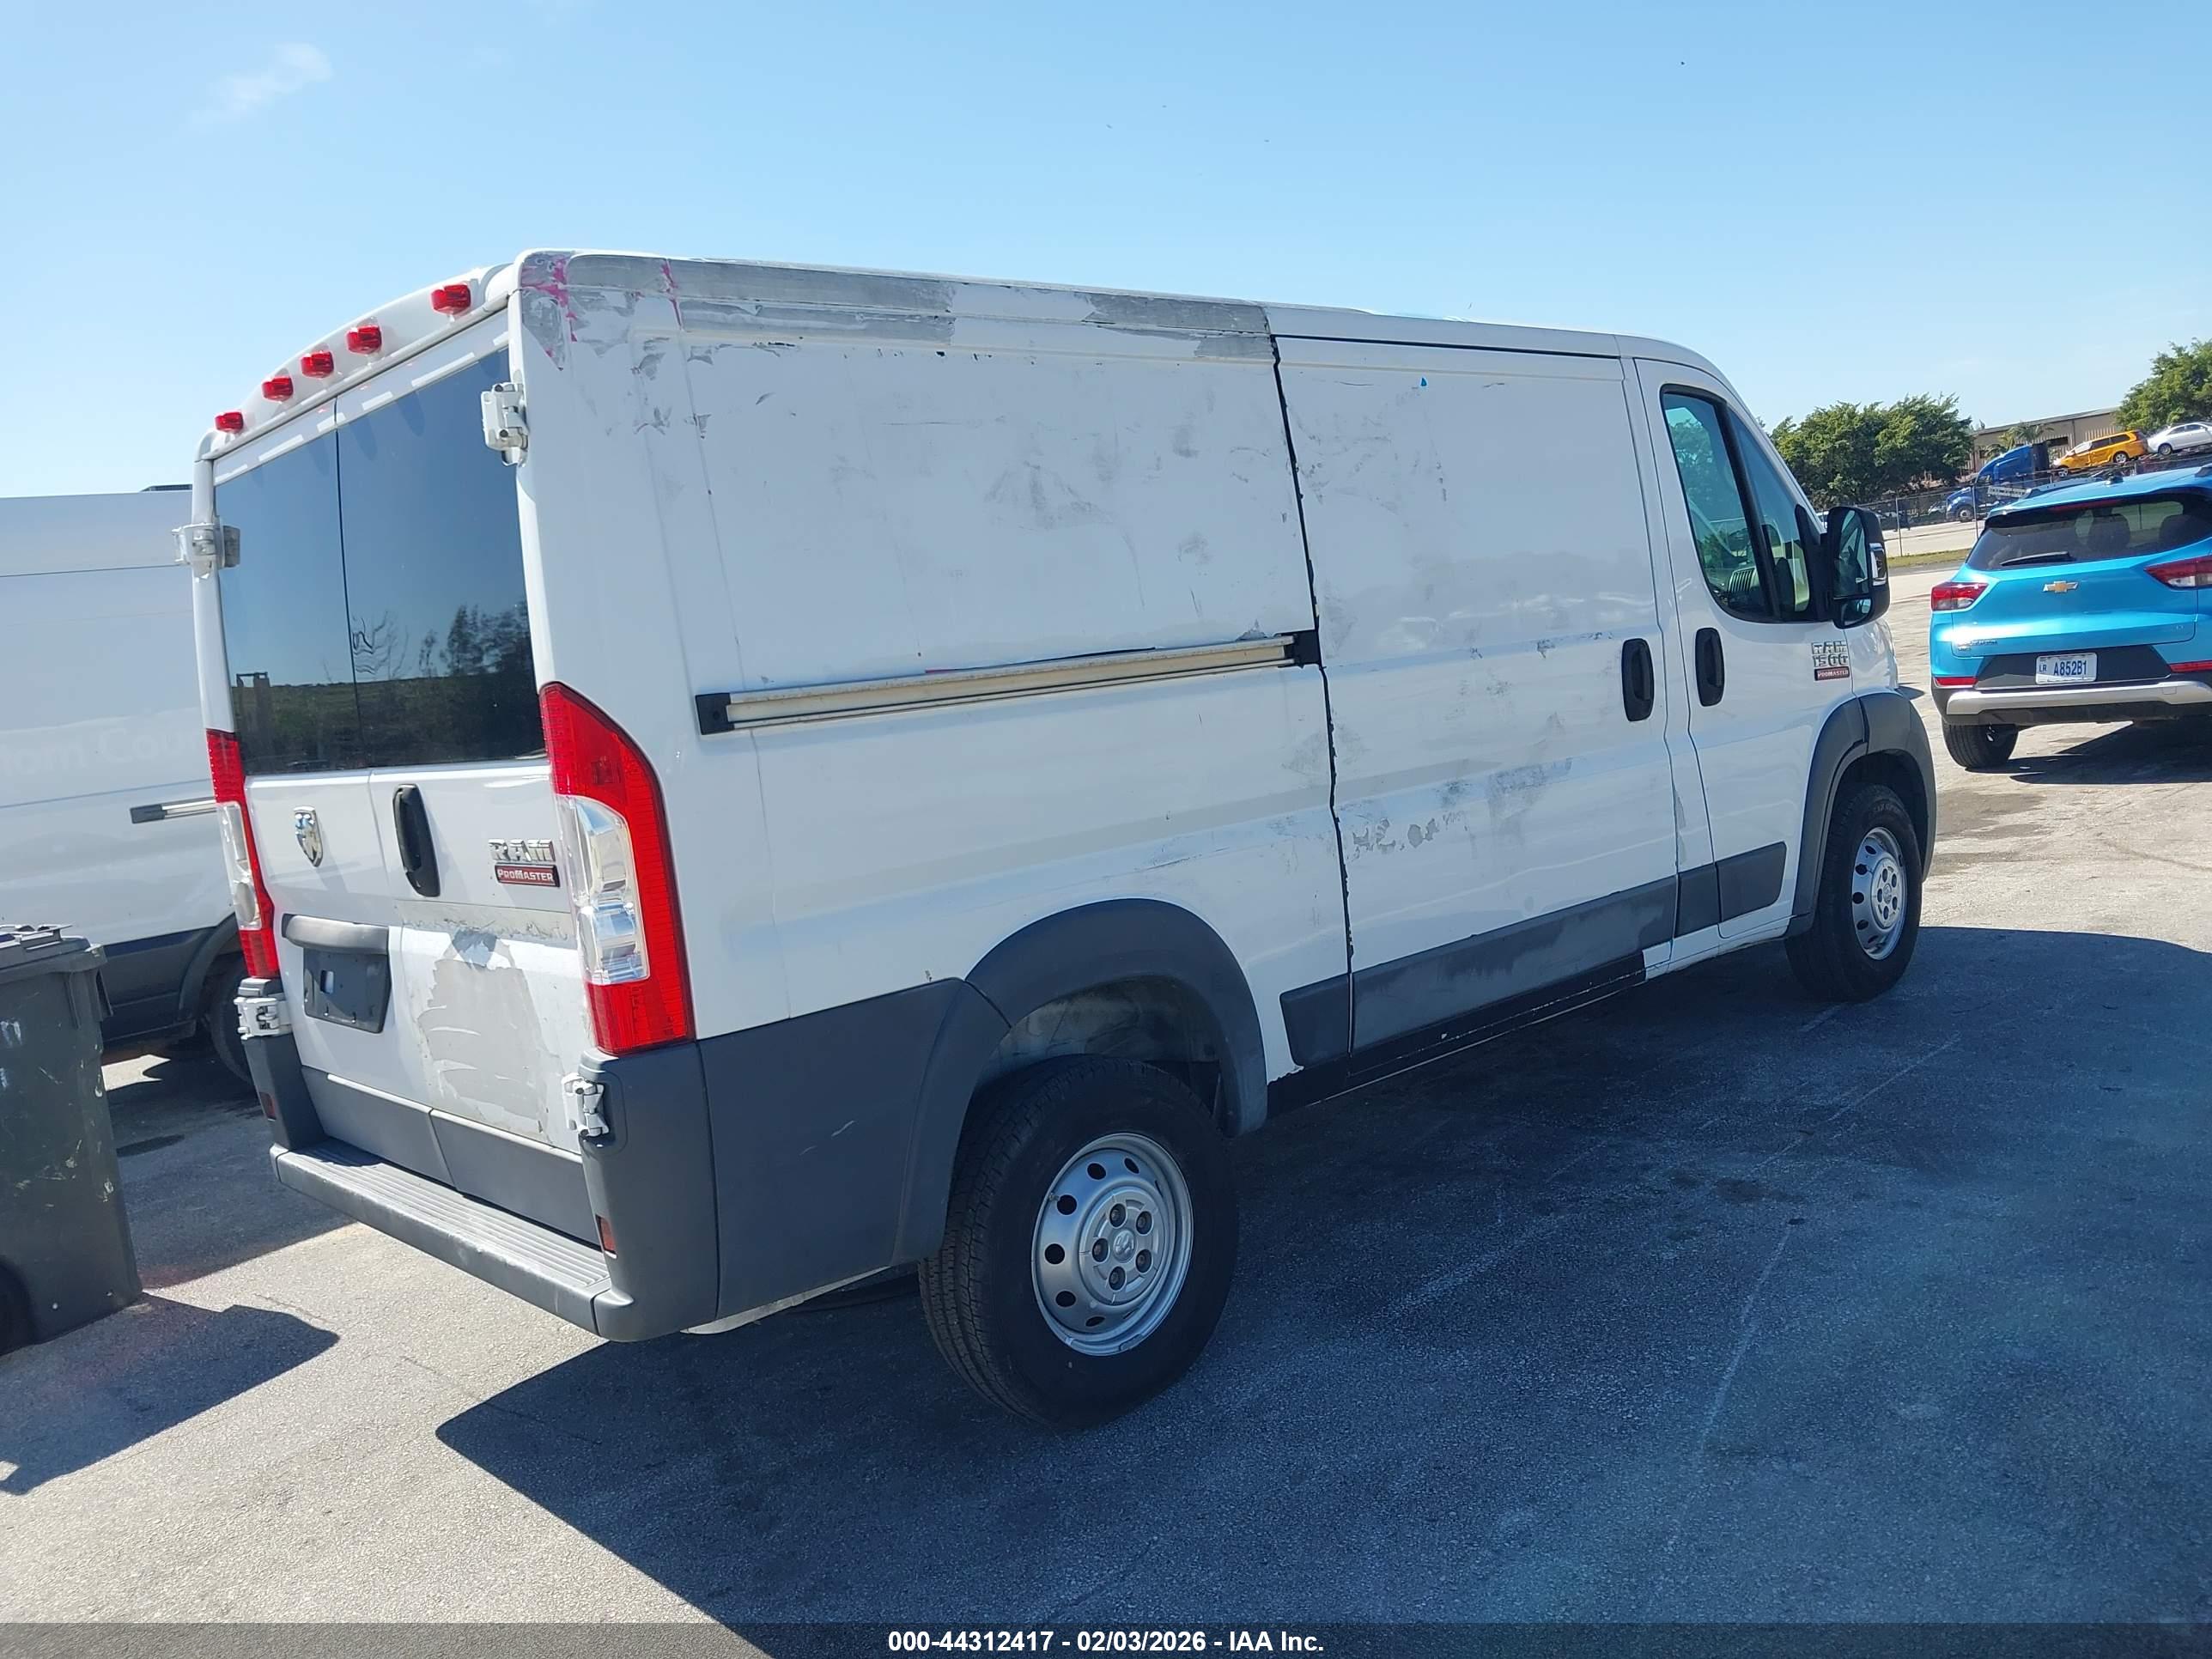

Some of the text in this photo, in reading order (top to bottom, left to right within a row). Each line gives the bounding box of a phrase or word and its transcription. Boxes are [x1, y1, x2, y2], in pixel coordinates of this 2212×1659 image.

[1813, 653, 1849, 667] 1500
[2053, 659, 2087, 676] A852B1
[488, 838, 556, 862] RAM
